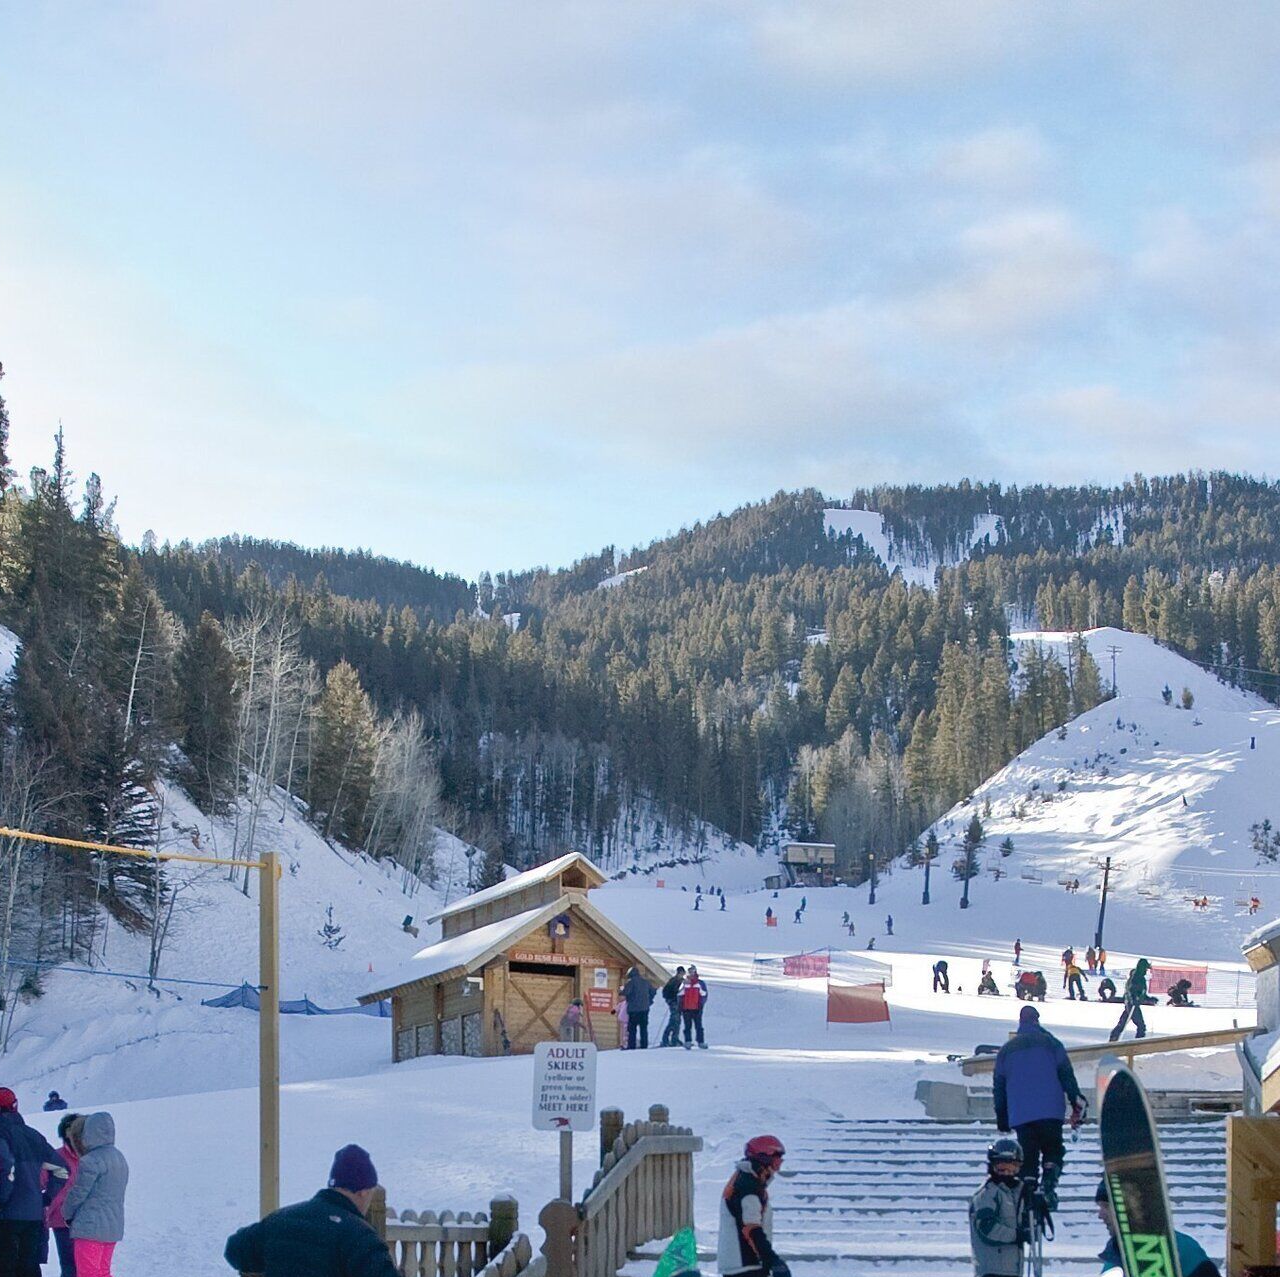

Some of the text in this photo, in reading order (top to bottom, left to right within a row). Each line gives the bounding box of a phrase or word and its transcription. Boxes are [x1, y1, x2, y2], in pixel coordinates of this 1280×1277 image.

[515, 953, 533, 961] GOLD
[547, 1048, 587, 1059] ADULT
[547, 1061, 585, 1071] SKIERS
[538, 1103, 589, 1112] MEET HERE
